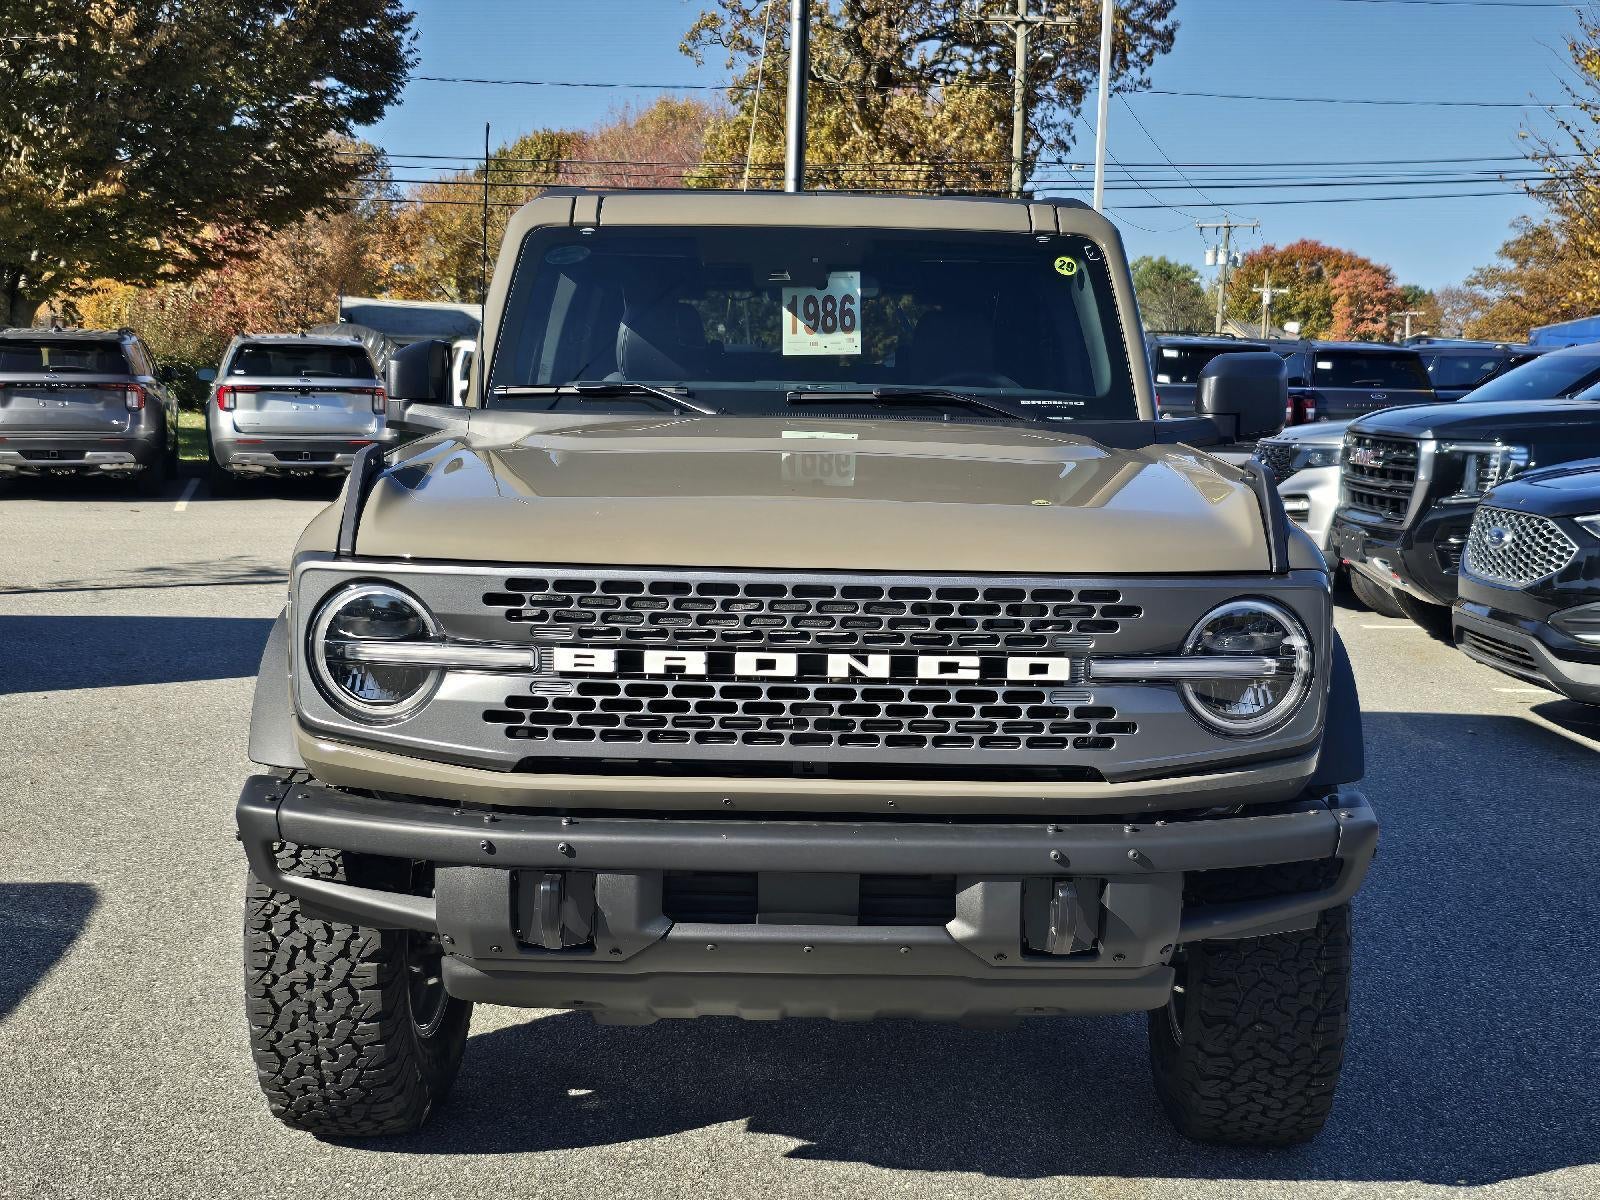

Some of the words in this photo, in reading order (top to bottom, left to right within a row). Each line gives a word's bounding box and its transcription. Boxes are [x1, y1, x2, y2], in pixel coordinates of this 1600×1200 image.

[1057, 259, 1075, 273] 29
[786, 293, 856, 336] 1986
[554, 647, 1070, 681] BRONCO
